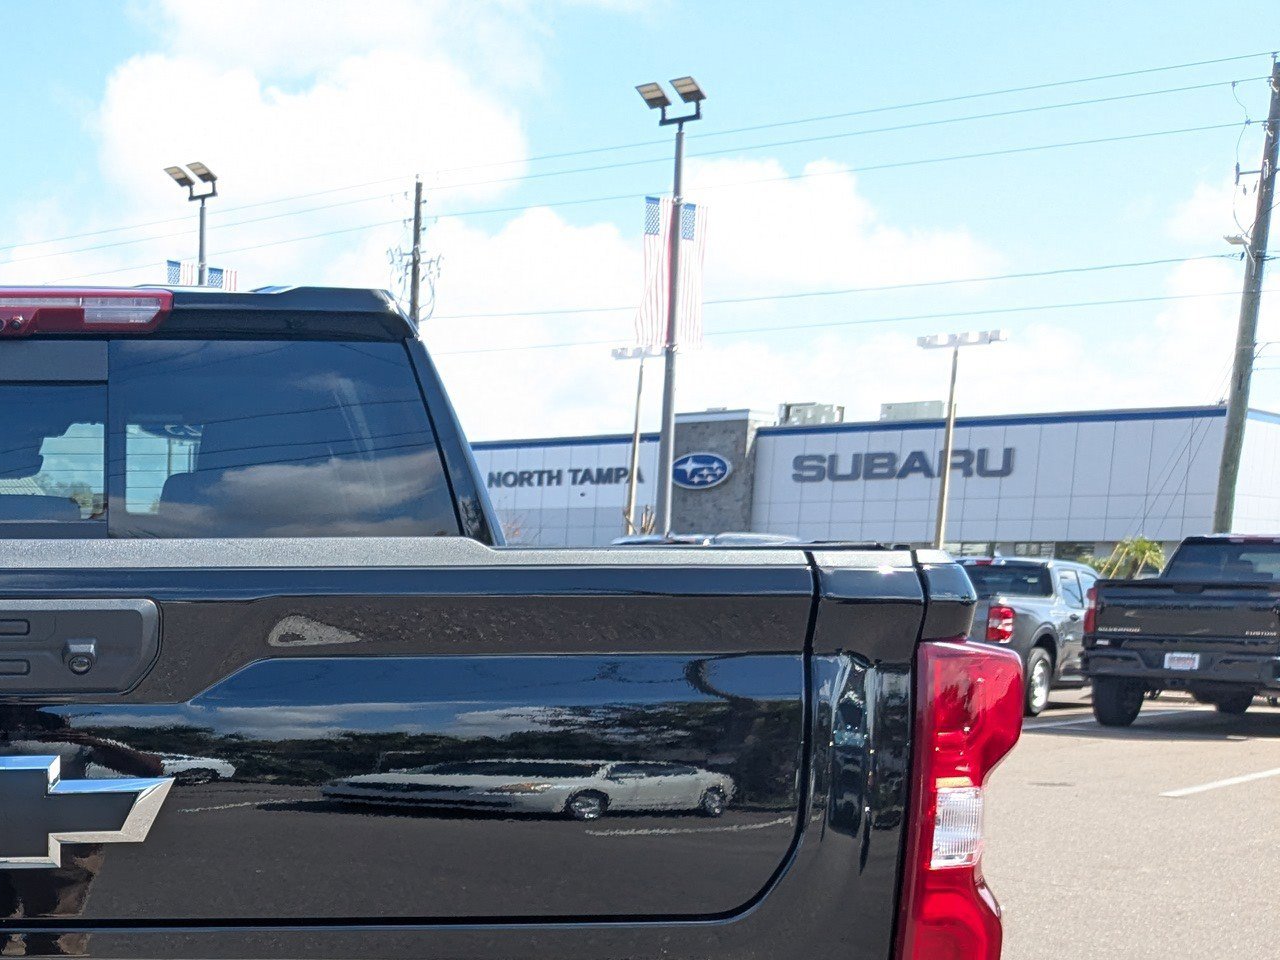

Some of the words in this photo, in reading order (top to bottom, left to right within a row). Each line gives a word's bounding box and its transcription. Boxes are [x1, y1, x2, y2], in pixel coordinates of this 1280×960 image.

[487, 469, 563, 489] NORTH
[567, 465, 645, 486] TAMPA
[791, 447, 1017, 483] SUBARU
